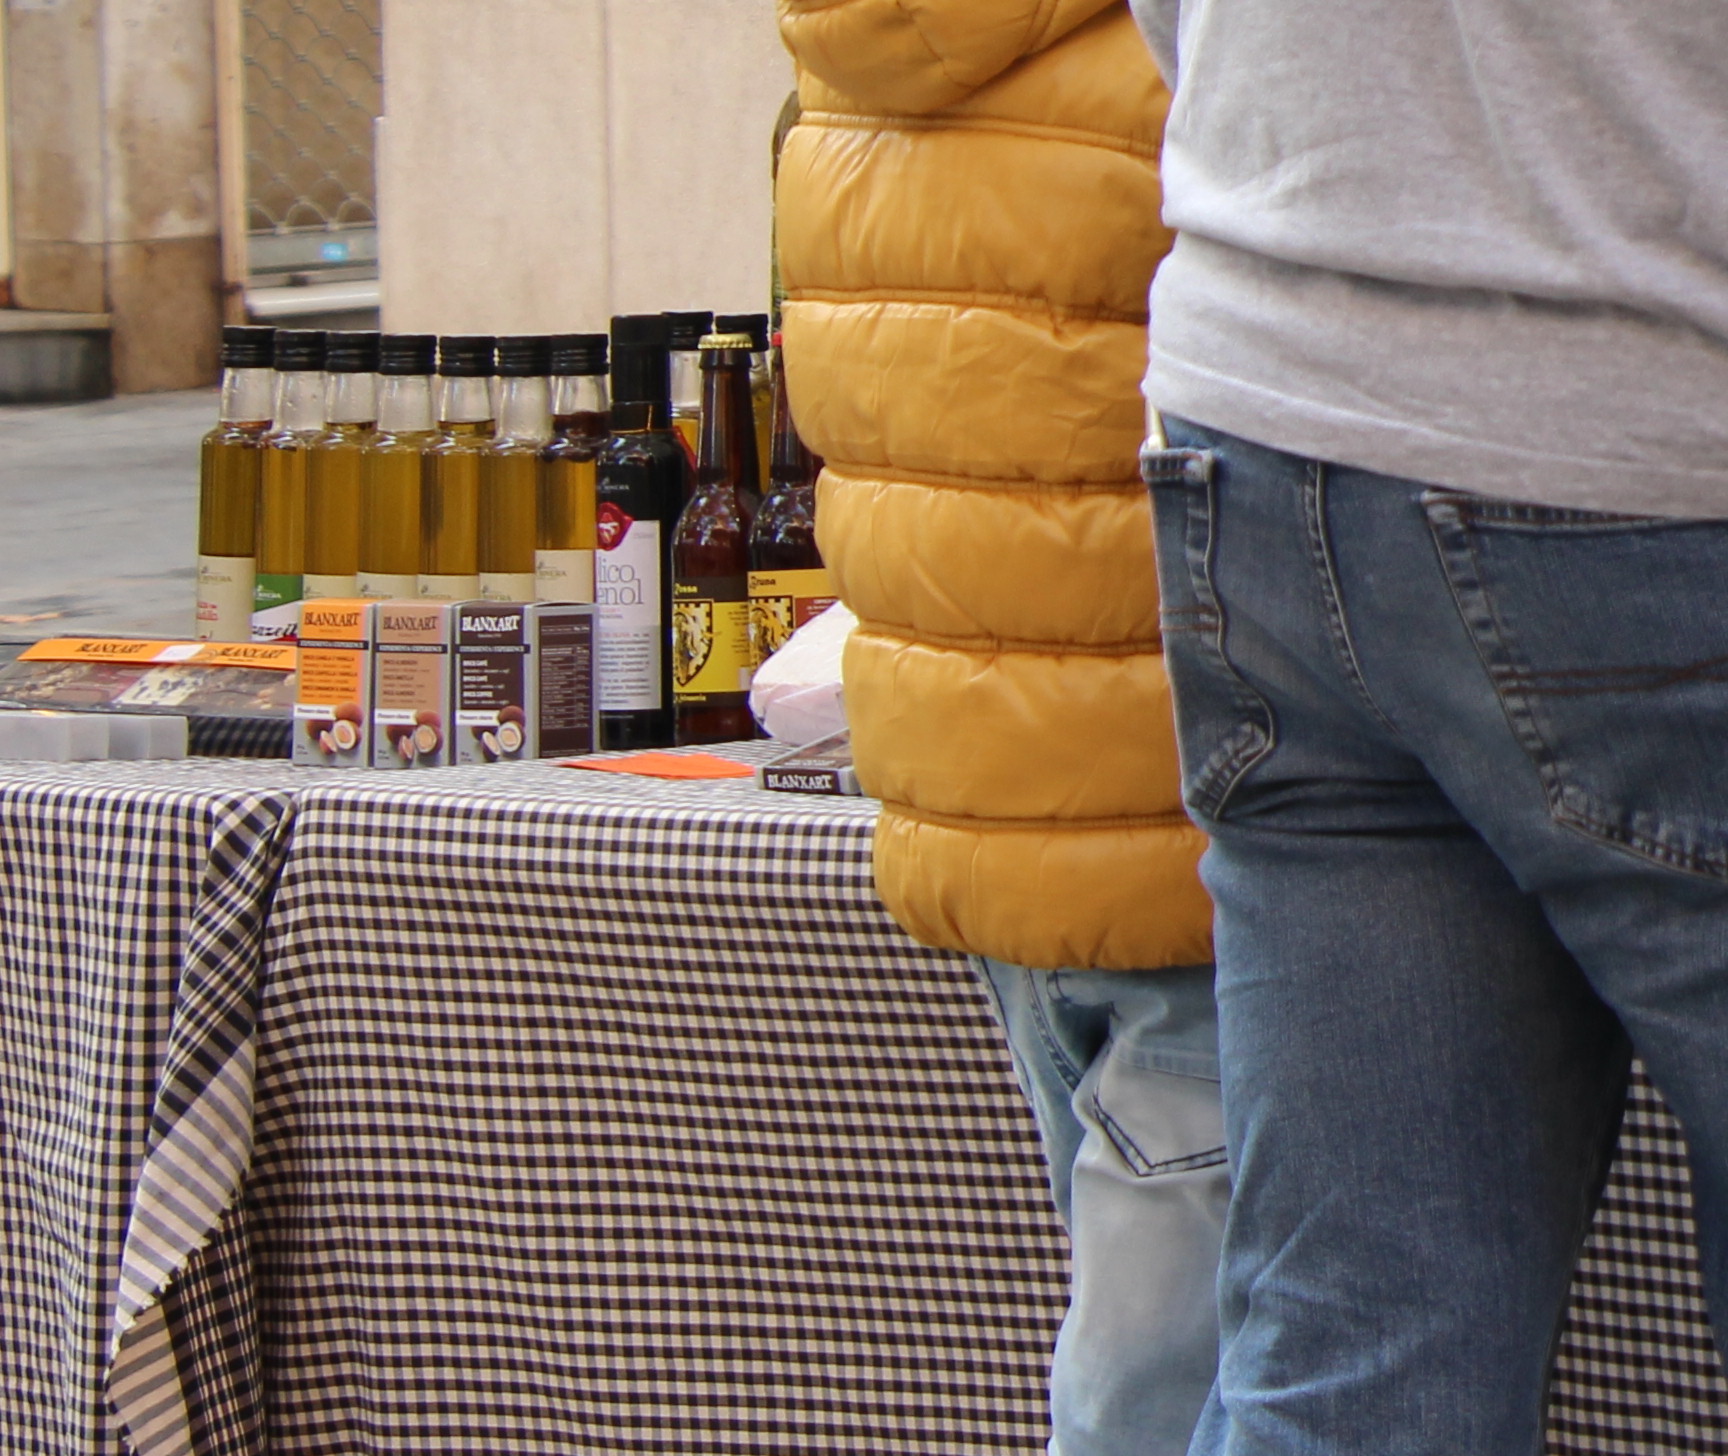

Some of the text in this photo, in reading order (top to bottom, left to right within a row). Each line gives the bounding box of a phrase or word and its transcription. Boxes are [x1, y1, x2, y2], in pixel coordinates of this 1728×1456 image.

[303, 611, 361, 627] BLANXART
[382, 614, 440, 631] BLANXART
[461, 614, 521, 632] BLANXART
[767, 773, 833, 789] BLANXART
